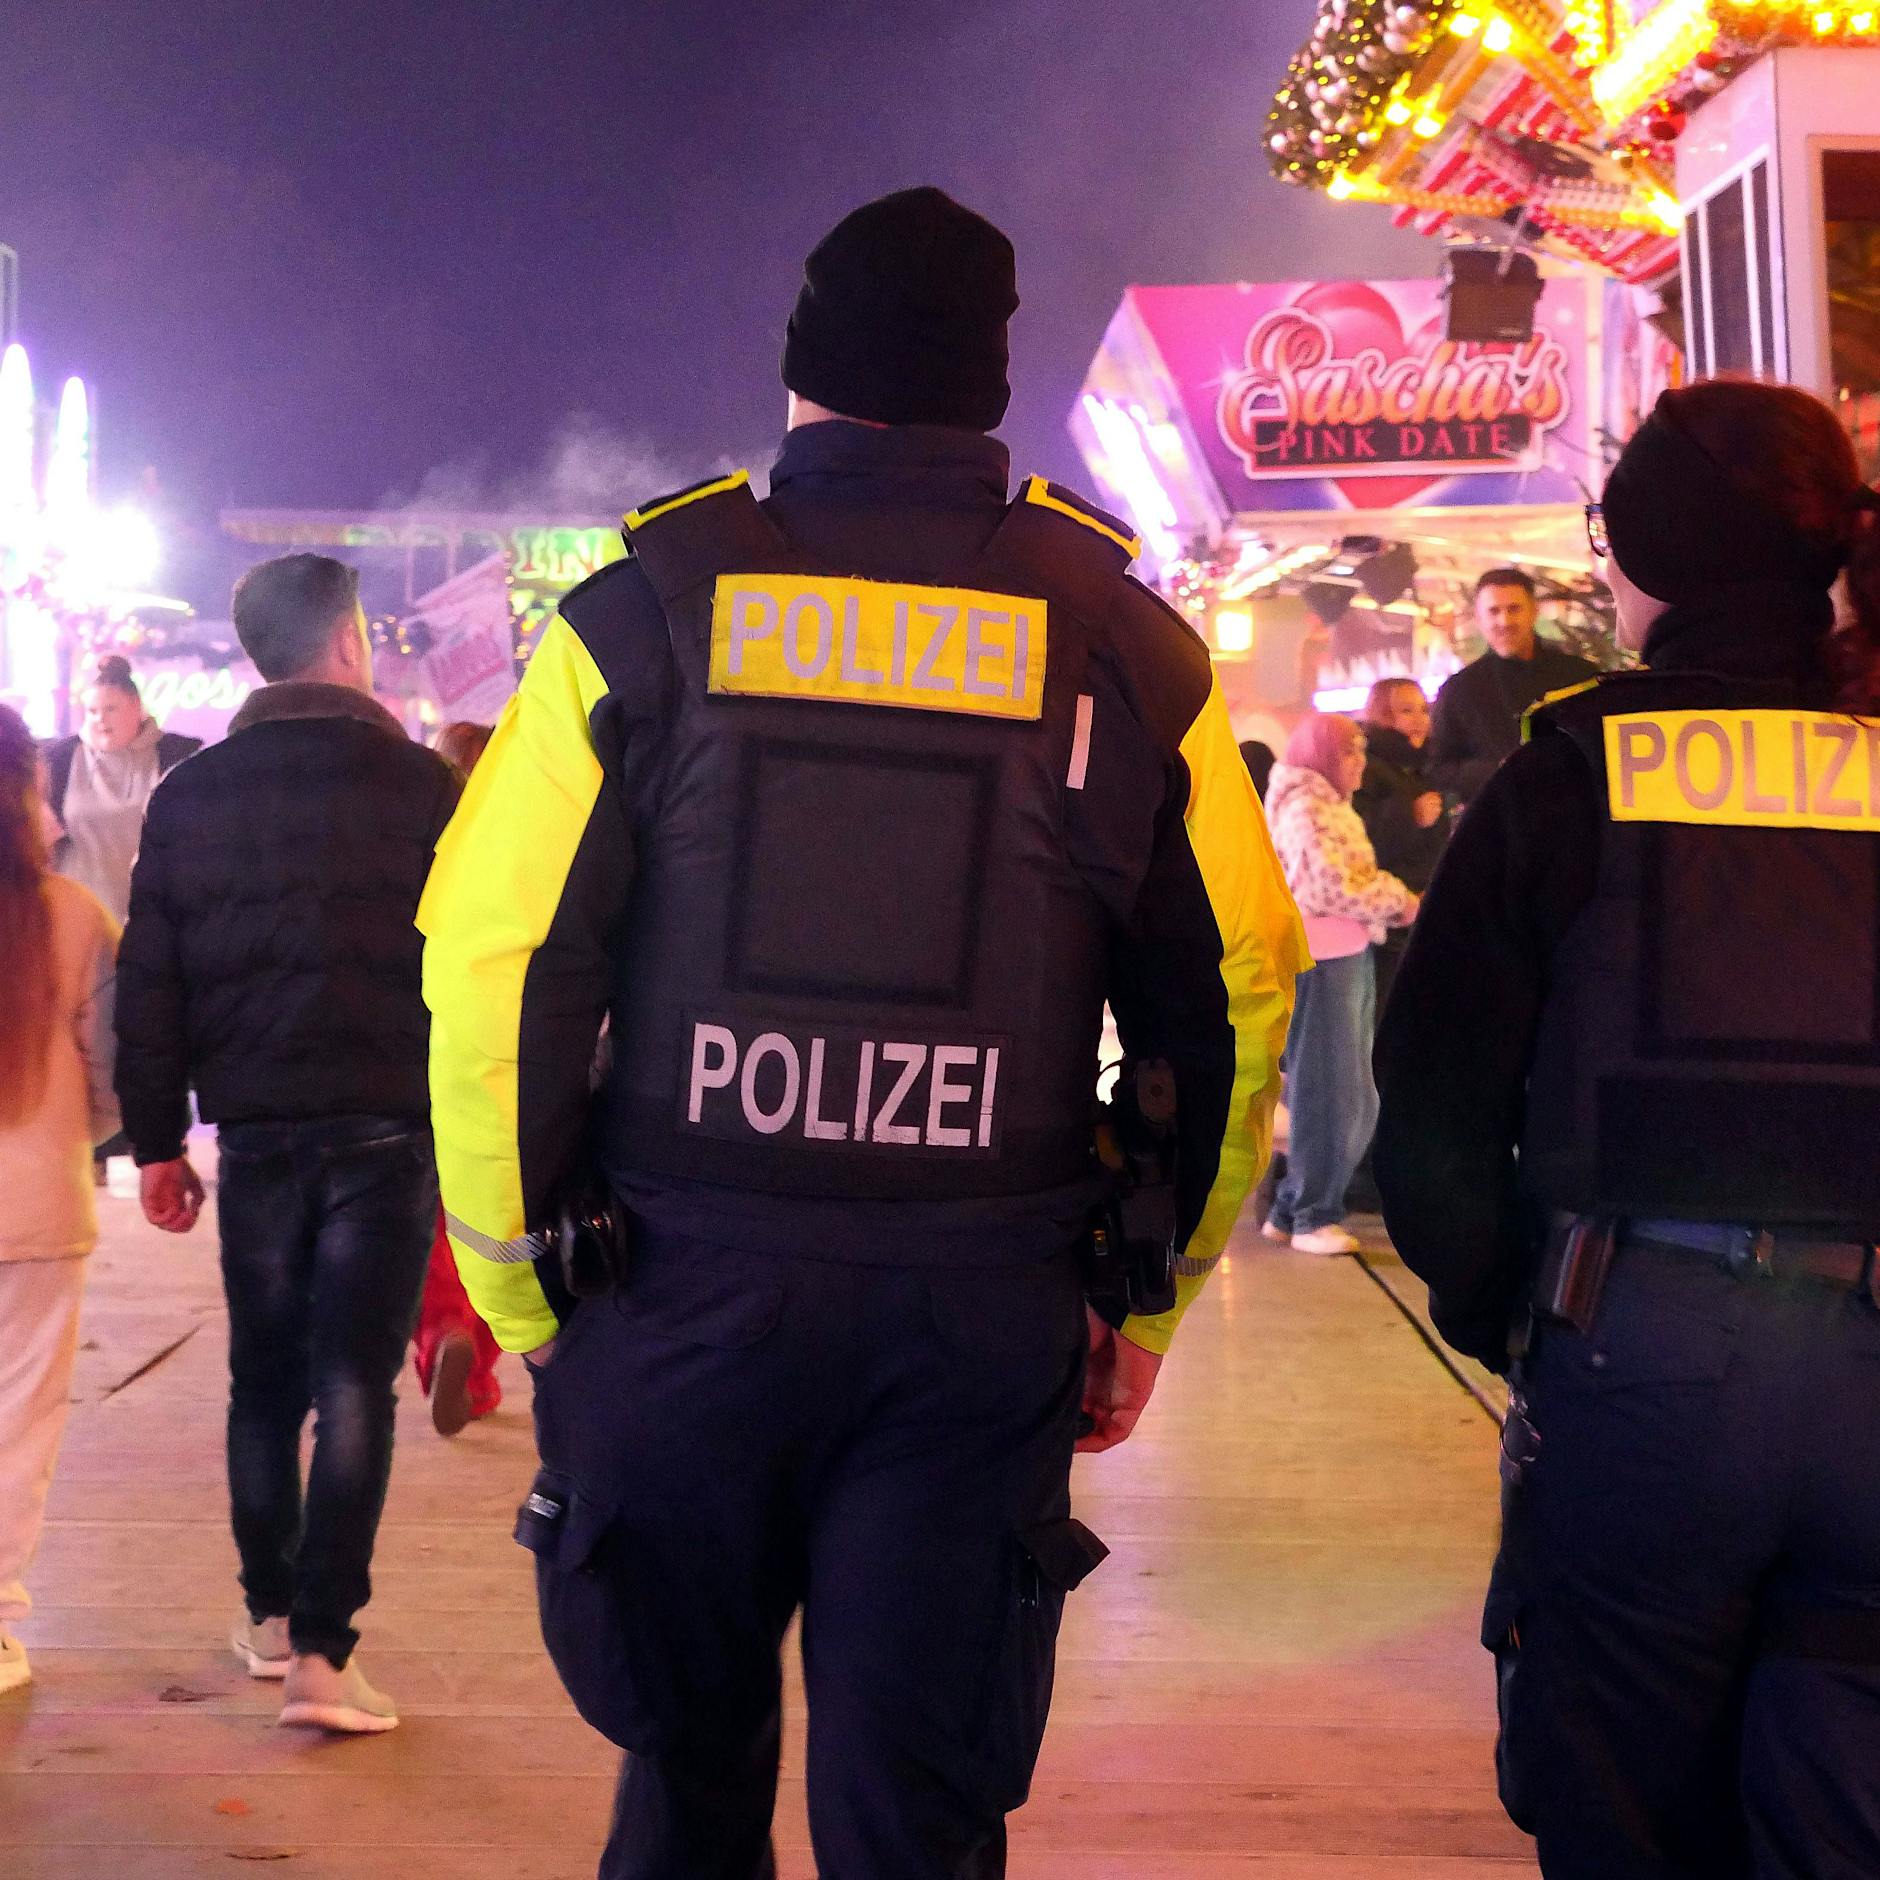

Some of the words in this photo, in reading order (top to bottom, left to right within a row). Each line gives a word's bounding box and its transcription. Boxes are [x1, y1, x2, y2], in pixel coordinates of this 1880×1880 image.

[1279, 427, 1377, 461] PINK
[1400, 423, 1512, 458] DATE
[727, 591, 1029, 699] POLIZEI
[688, 1022, 999, 1147] POLIZEI
